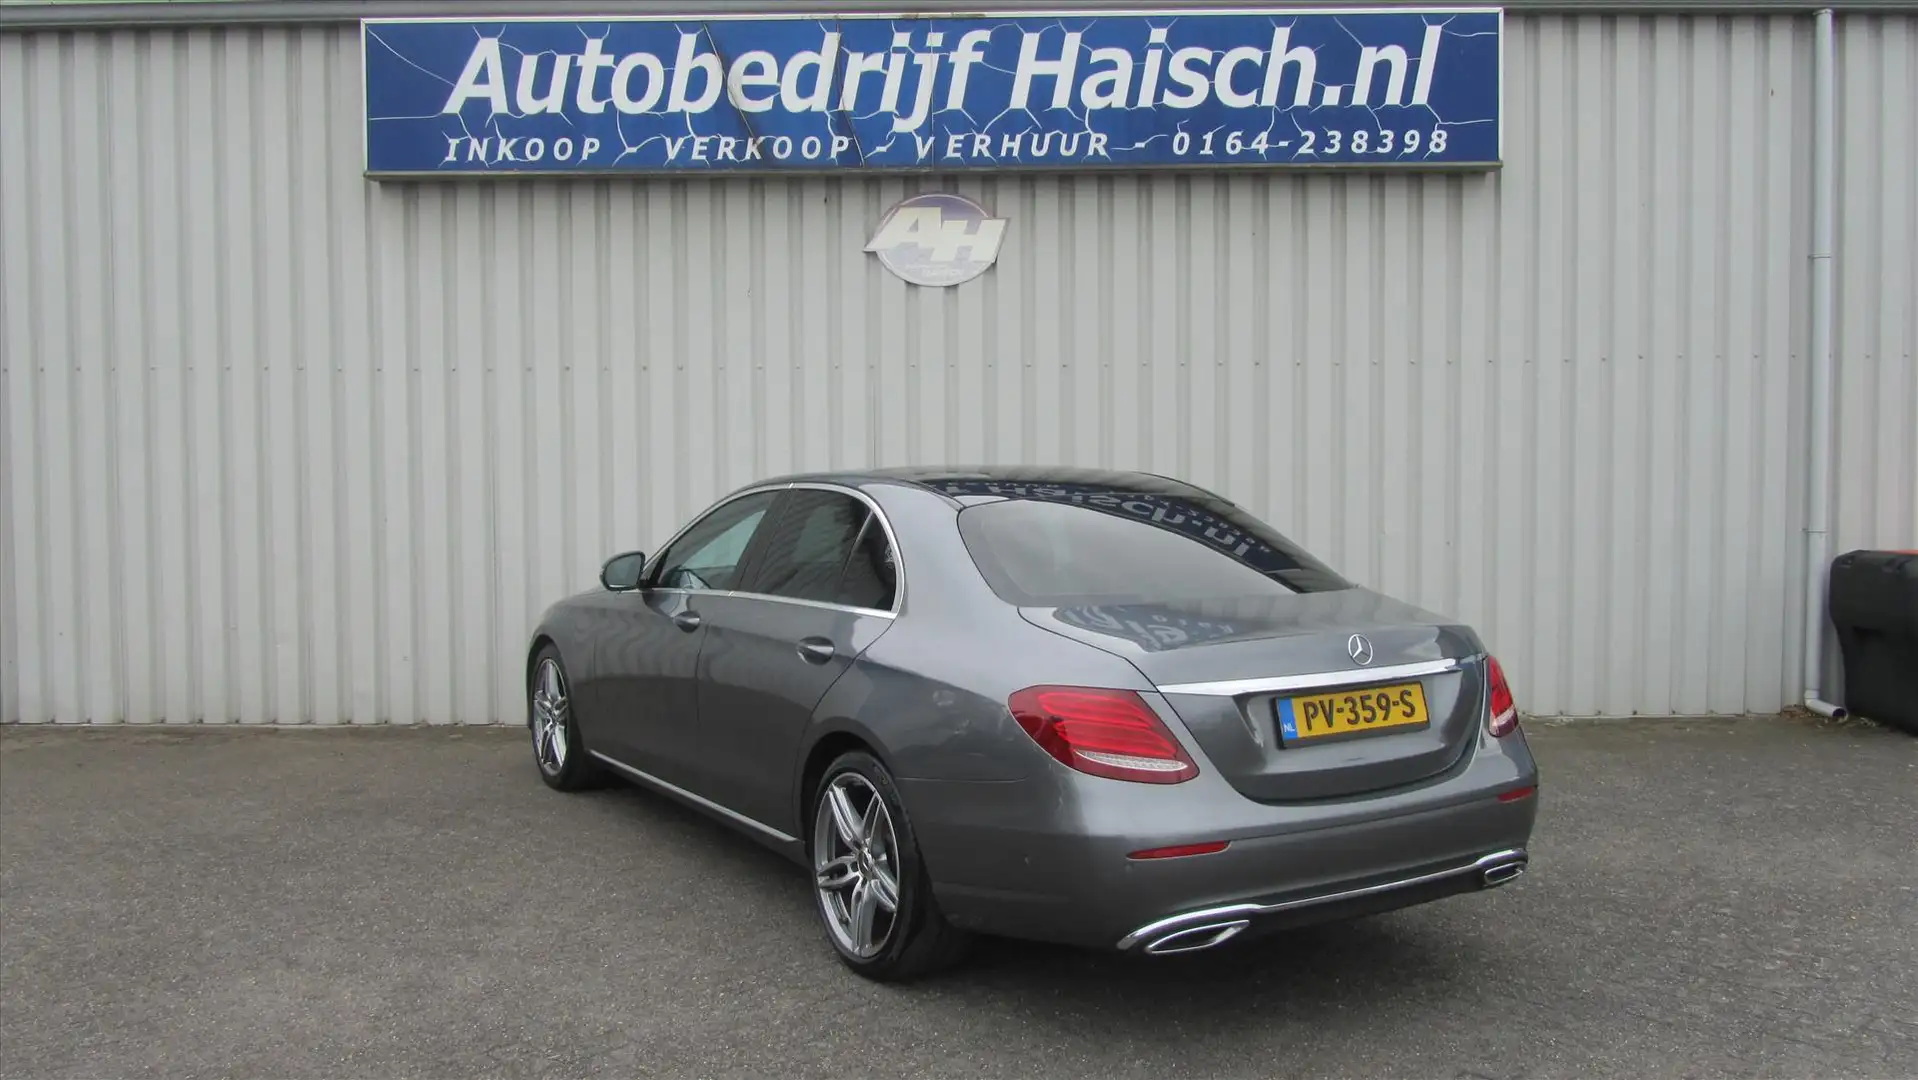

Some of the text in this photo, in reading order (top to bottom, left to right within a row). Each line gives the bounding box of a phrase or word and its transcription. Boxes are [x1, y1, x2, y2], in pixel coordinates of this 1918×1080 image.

[442, 25, 1442, 133] Autobedrijf Haisch.nl
[444, 137, 600, 162] INKOOP
[665, 136, 850, 162] VERKOOP
[915, 132, 1109, 161] VERHUUR
[1172, 129, 1449, 155] 0164-238398
[863, 207, 1006, 262] AH
[1283, 723, 1296, 733] NL
[1302, 689, 1417, 731] PV-359-S
